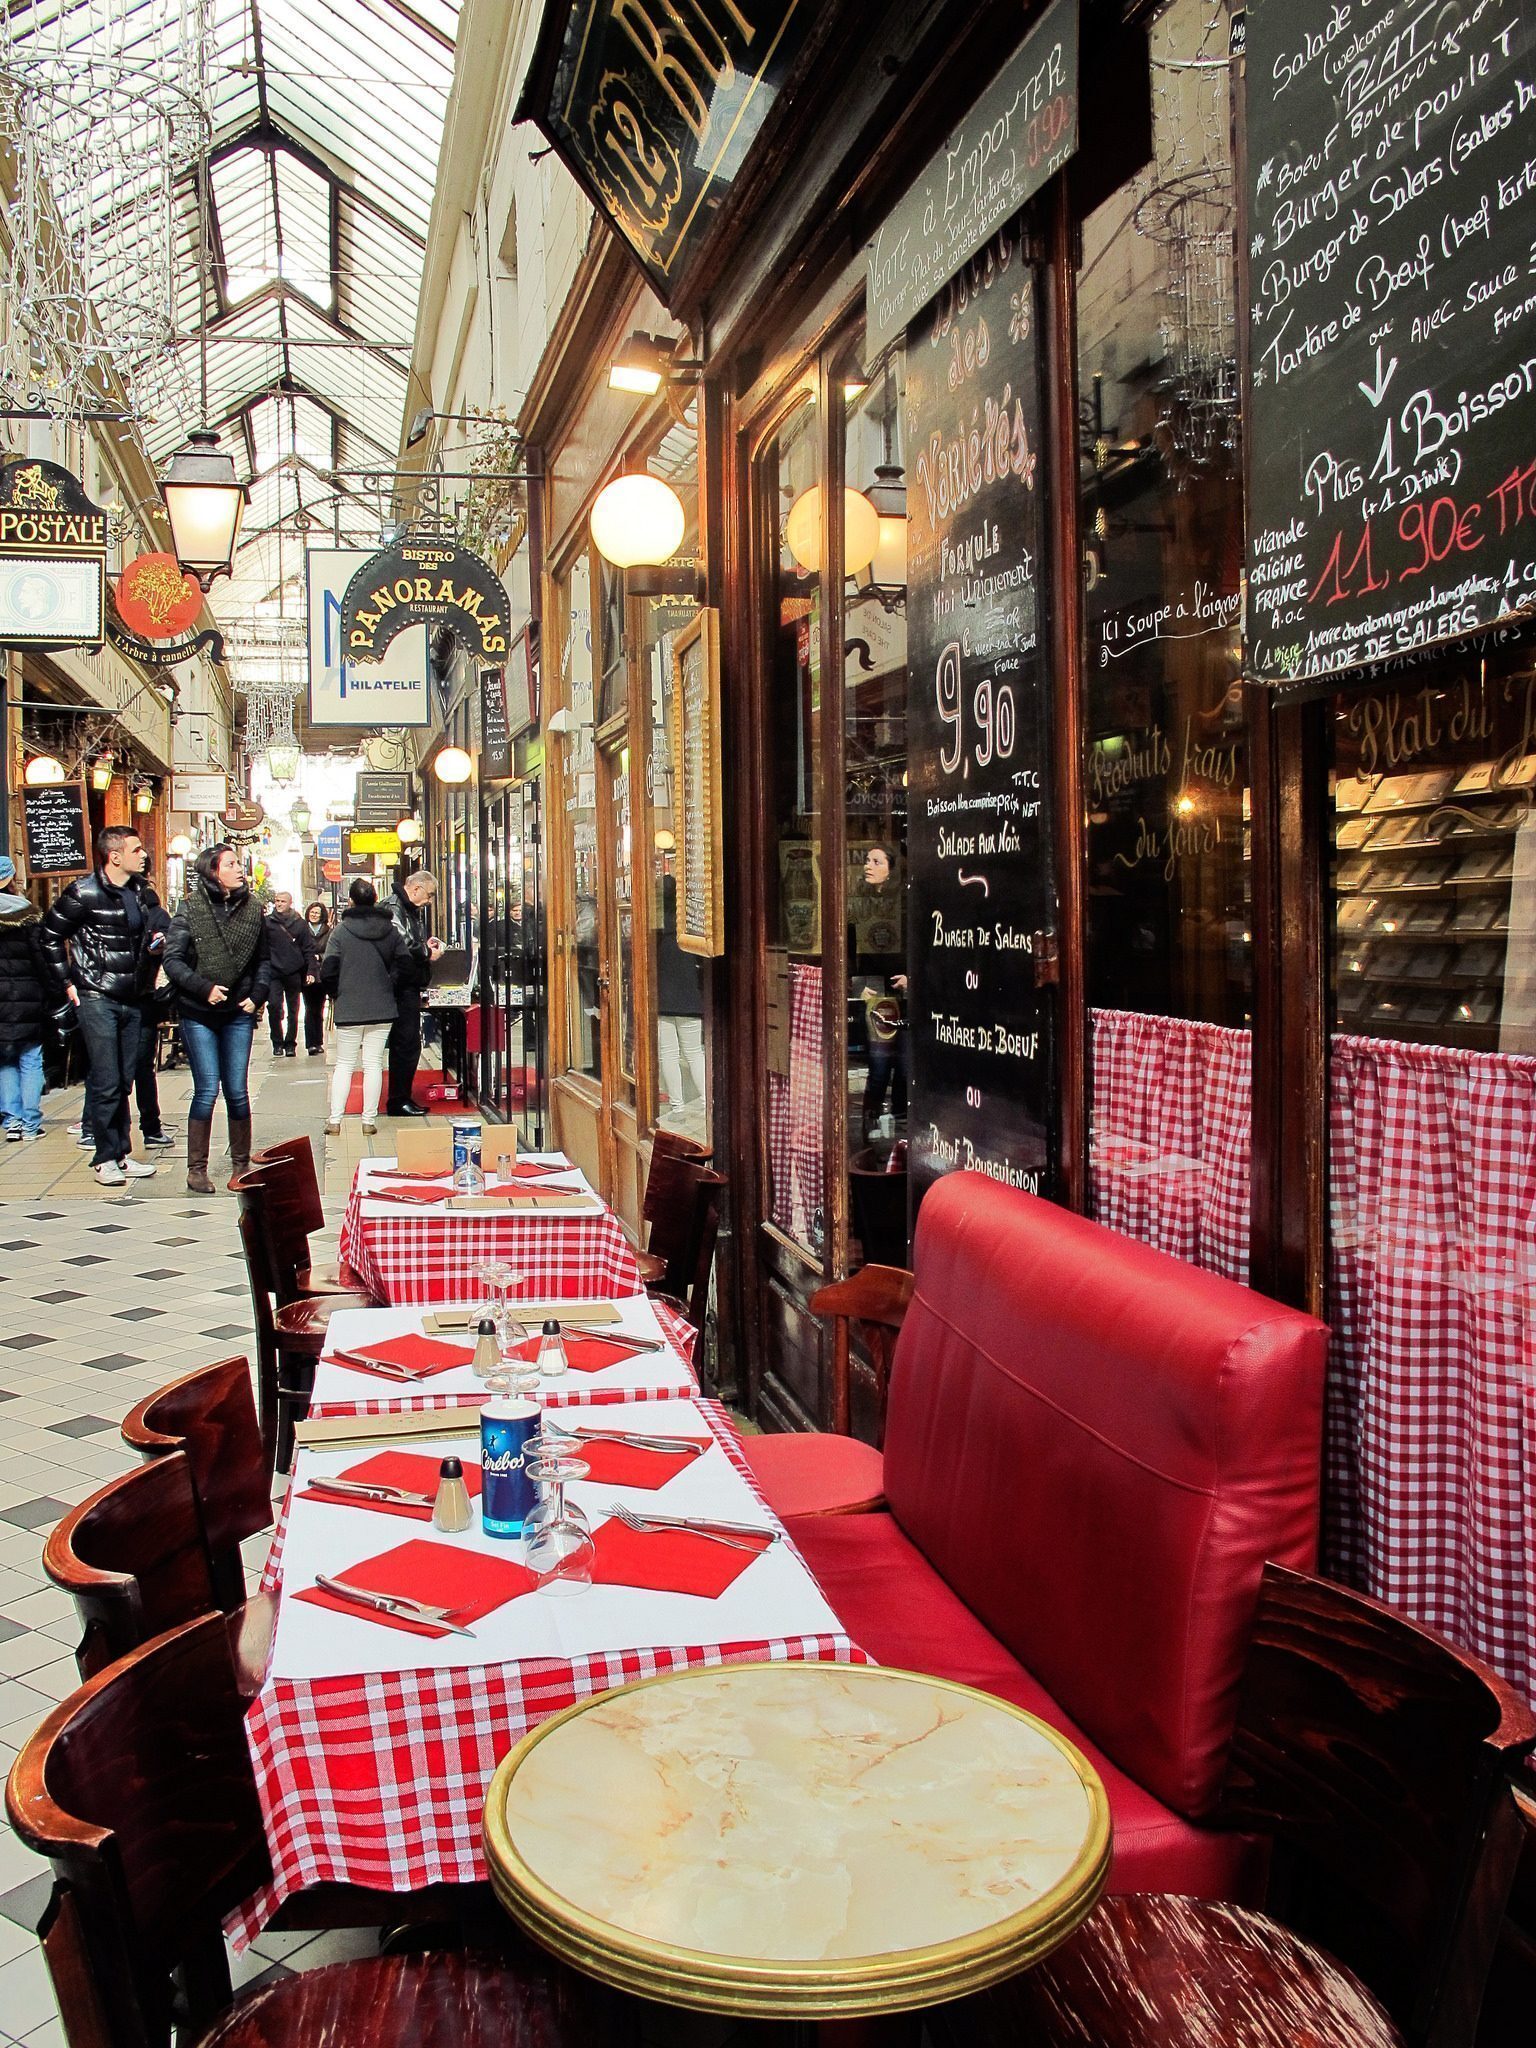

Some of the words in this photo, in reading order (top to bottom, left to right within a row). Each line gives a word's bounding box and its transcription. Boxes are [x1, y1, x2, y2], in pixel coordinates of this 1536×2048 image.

[1273, 5, 1351, 100] Salade
[1340, 0, 1438, 112] PLAT
[1272, 153, 1367, 250] Burger
[1261, 231, 1346, 321] Burger
[1349, 209, 1369, 245] de
[1369, 157, 1443, 225] Salers
[1260, 308, 1339, 384] Tartare
[1342, 302, 1361, 331] de
[1305, 452, 1363, 517] Plus
[1369, 418, 1401, 483] 1
[1, 513, 104, 543] POSTALE
[22, 514, 104, 523] PHILATELIE
[402, 549, 455, 562] BISTRO
[419, 562, 438, 570] DES
[350, 578, 506, 653] PANORAMAS
[410, 604, 448, 614] RESTAURANT
[1192, 580, 1241, 627] l'oigno
[115, 634, 148, 661] L'Arbre
[151, 651, 157, 662] à
[161, 641, 198, 663] cannelle
[1365, 634, 1393, 661] DE
[1396, 604, 1479, 650] SALERS
[965, 970, 978, 990] OU
[995, 1024, 1039, 1060] BOEUF
[966, 1086, 981, 1108] OU
[482, 1449, 525, 1471] Cérébos
